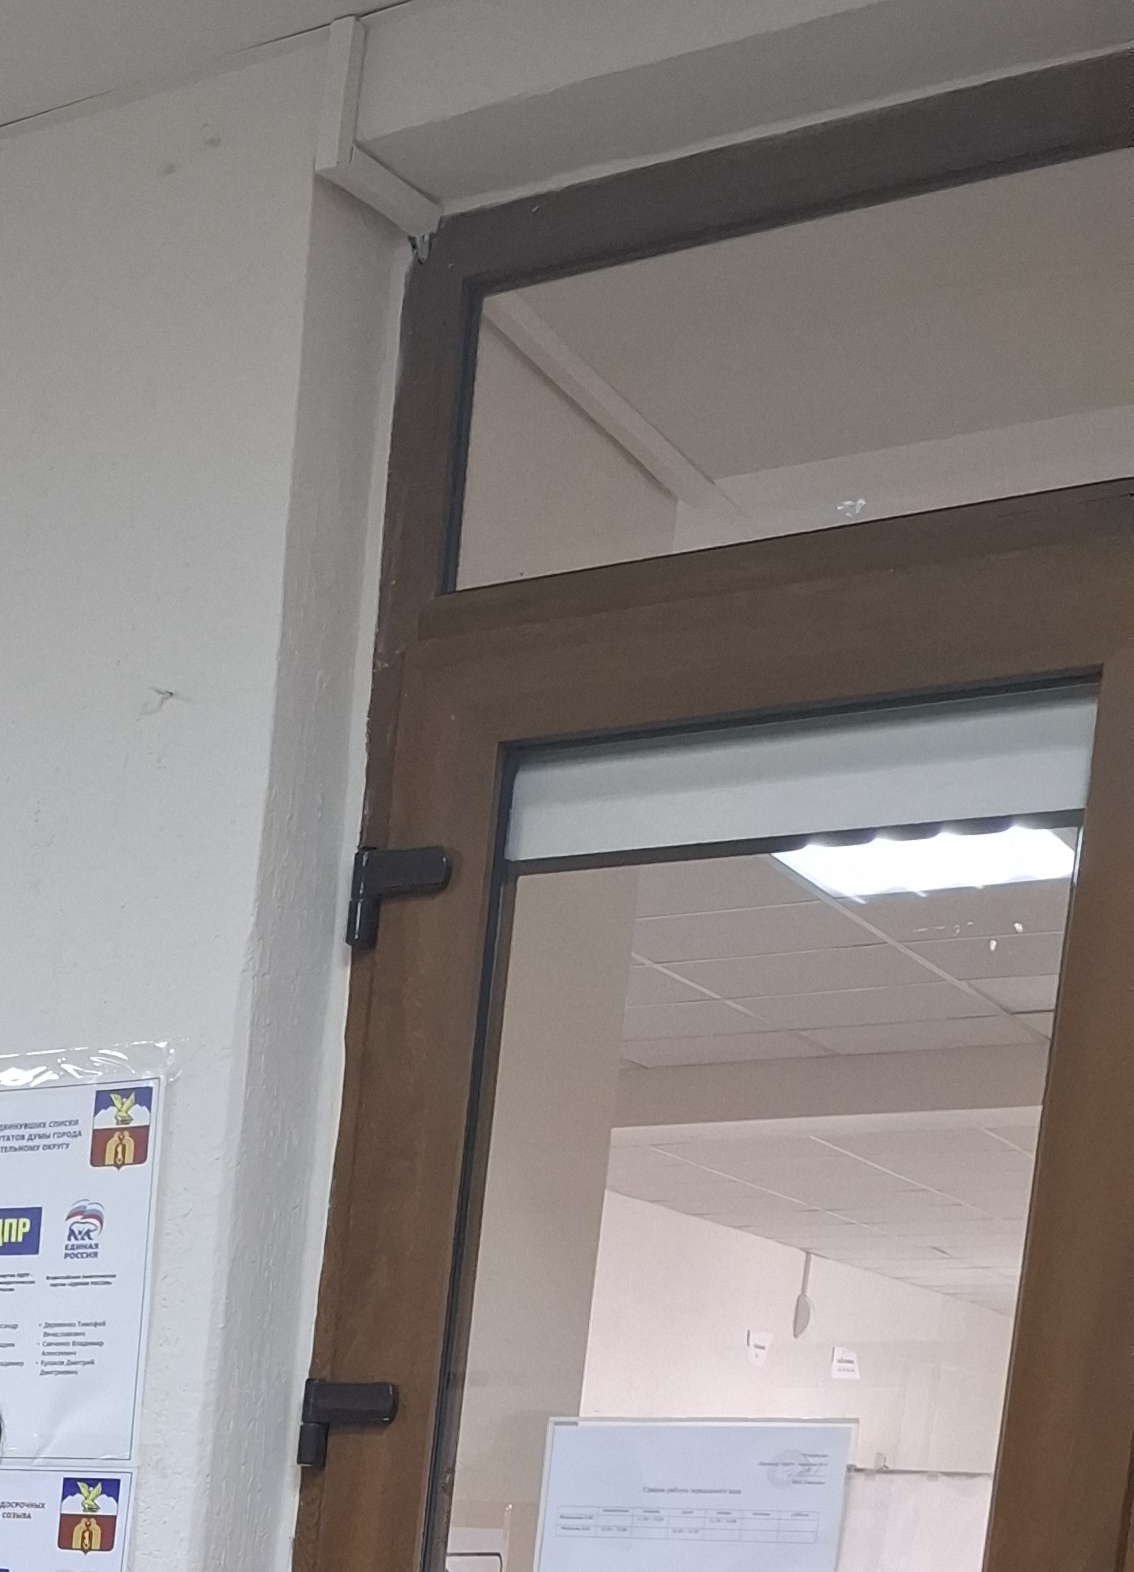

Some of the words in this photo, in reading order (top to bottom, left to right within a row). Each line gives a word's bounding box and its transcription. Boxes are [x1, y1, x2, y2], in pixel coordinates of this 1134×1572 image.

[48, 1119, 79, 1128] СПИСКИ
[26, 1133, 51, 1142] ДУМЫ
[52, 1130, 83, 1140] ГОРОДА
[41, 1143, 70, 1151] ОКРУГУ
[64, 1242, 99, 1251] ЕДИНАЯ
[64, 1251, 98, 1260] РОССИЯ
[0, 1501, 46, 1510] ДОСРОЧНЫХ
[2, 1512, 32, 1520] СОЗЫВА
